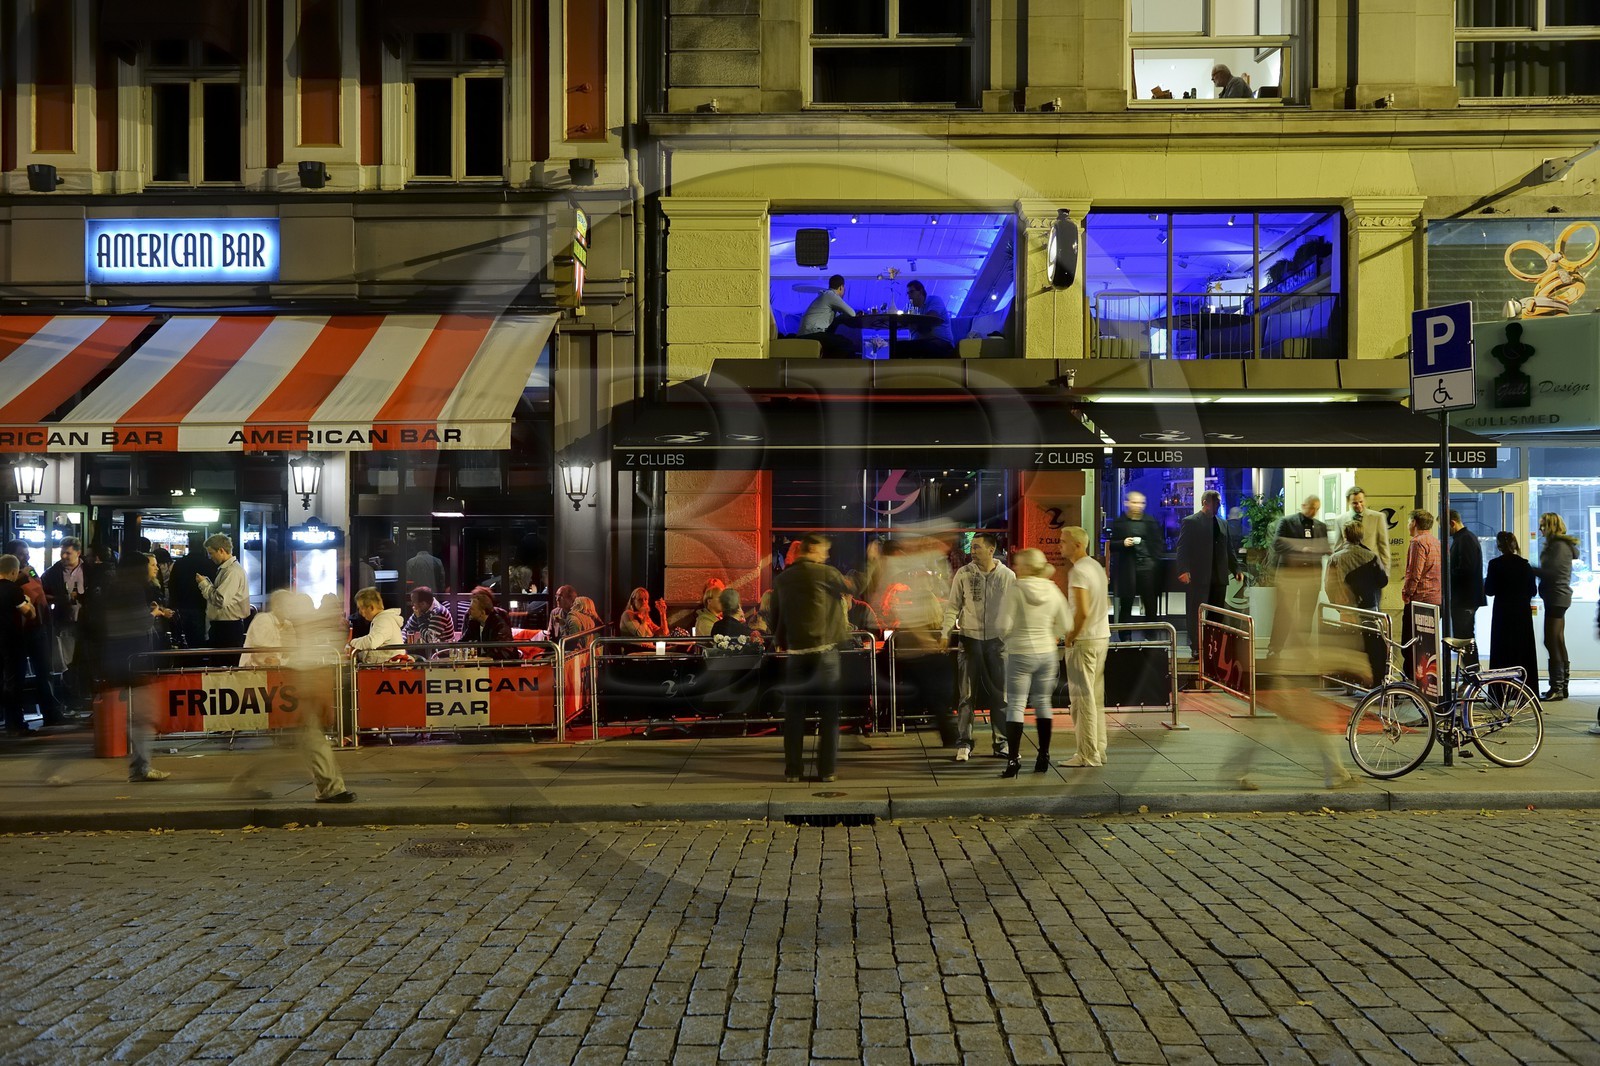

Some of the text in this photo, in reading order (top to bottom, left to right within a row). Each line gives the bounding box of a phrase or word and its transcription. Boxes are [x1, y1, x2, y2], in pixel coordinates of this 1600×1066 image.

[97, 233, 266, 268] AMERICAN BAR
[1425, 315, 1456, 366] P
[1538, 380, 1591, 396] Design
[101, 431, 163, 446] BAR
[228, 428, 462, 444] AMERICAN BAR
[626, 453, 685, 466] Z CLUBS
[1034, 452, 1094, 464] Z CLUBS
[1123, 450, 1183, 463] Z CLUBS
[1424, 451, 1486, 463] Z LUBS
[375, 677, 540, 696] AMERICAN
[426, 700, 489, 717] BAR
